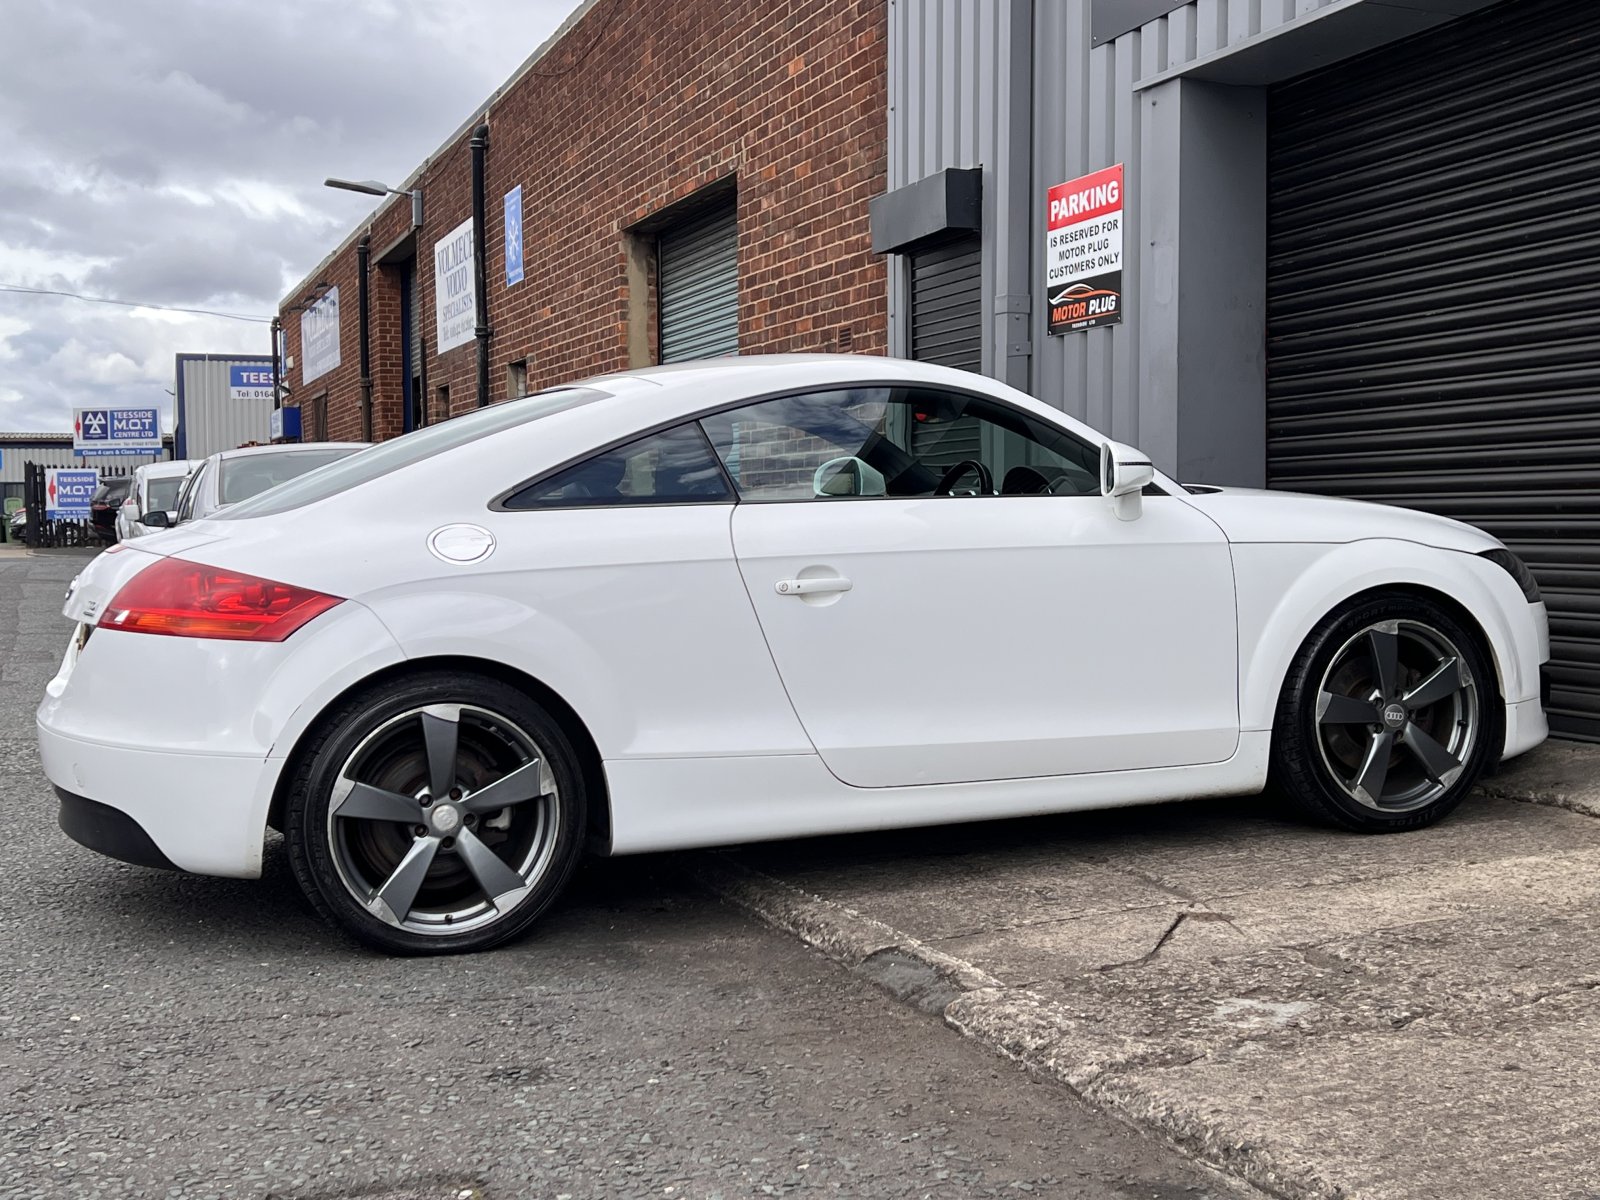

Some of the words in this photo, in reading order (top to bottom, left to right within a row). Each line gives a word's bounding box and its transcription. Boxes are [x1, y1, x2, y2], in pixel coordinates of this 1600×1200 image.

[1050, 180, 1119, 222] PARKING
[1050, 236, 1058, 248] IS
[1059, 225, 1100, 246] RESERVED
[1102, 219, 1119, 233] FOR
[1058, 245, 1086, 261] MOTOR
[1088, 238, 1109, 255] PLUG
[1049, 258, 1096, 280] CUSTOMERS
[1097, 252, 1120, 268] ONLY
[446, 266, 468, 299] VOLVO
[442, 292, 473, 322] SPECIALISTS
[1052, 301, 1087, 322] MOTOR
[1088, 295, 1117, 314] PLUG
[237, 390, 252, 398] Tel:
[113, 411, 153, 419] TEESSIDE
[113, 419, 153, 430] M.O.T
[58, 485, 95, 495] M.O.T
